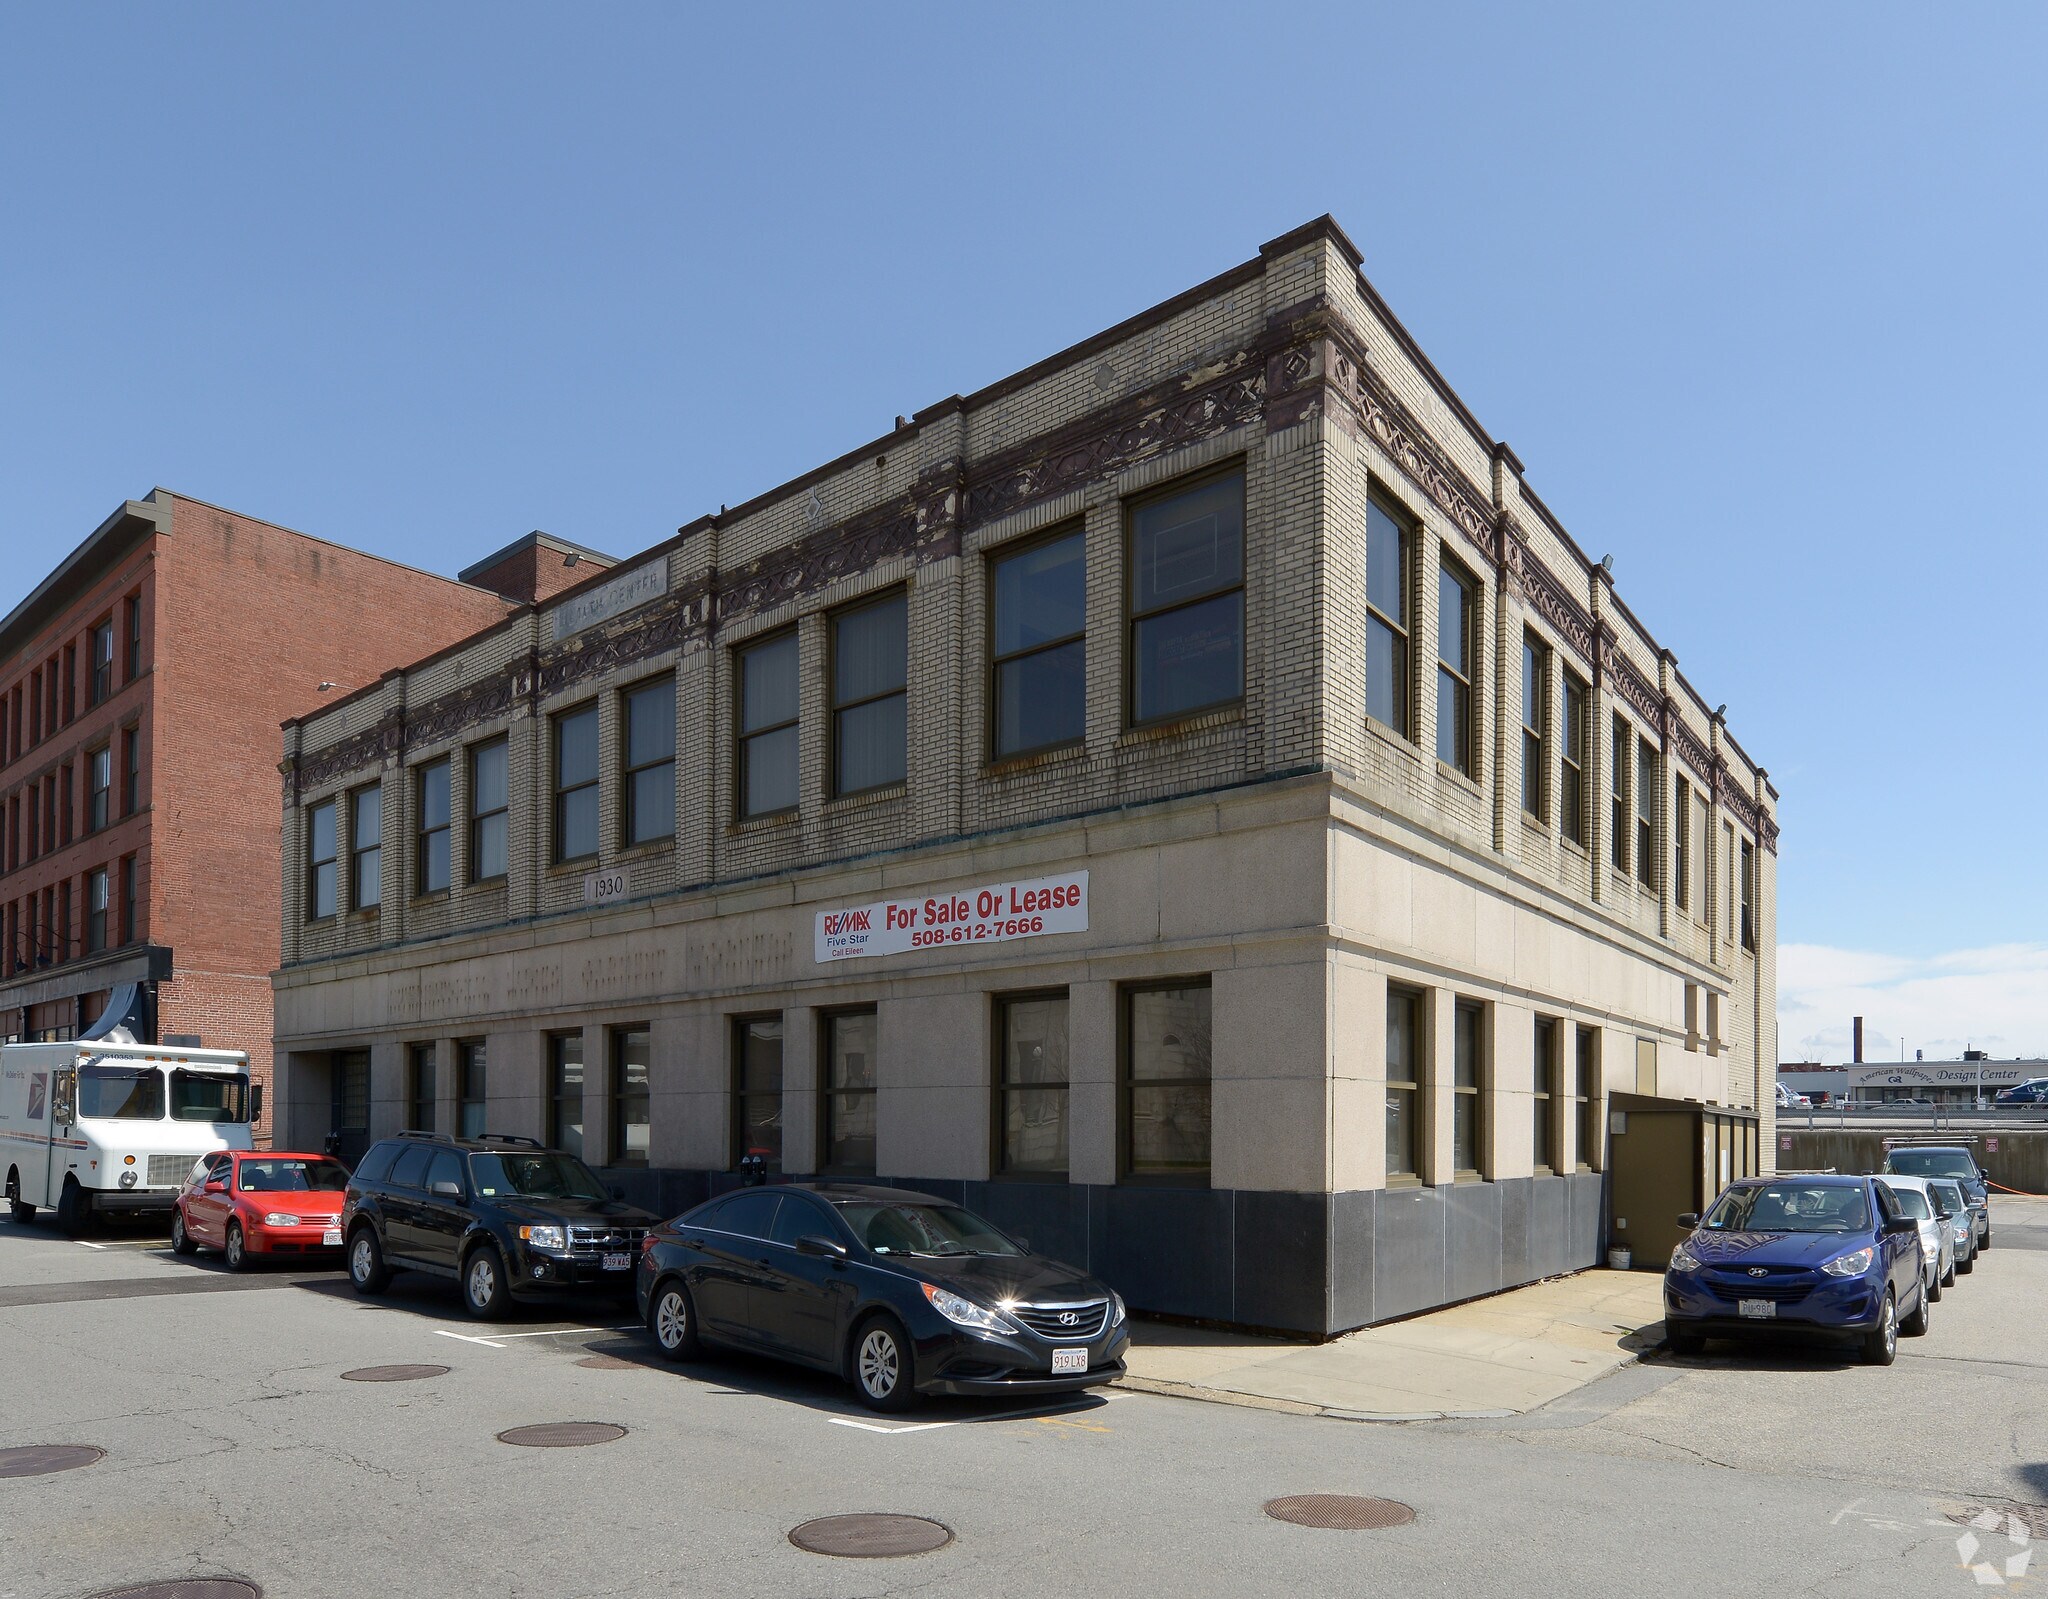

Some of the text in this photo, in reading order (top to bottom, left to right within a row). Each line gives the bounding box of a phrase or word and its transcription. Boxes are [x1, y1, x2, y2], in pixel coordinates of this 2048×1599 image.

[595, 876, 623, 897] 1930
[886, 883, 1081, 931] For Sale Or Lease
[824, 909, 872, 936] RE/MAX
[911, 916, 1043, 947] 508-612-7666
[827, 934, 869, 947] Five Star
[832, 947, 864, 957] Call Eileen
[1860, 1067, 1935, 1086] American Wallpaper
[1936, 1069, 2020, 1082] Design Center
[1054, 1355, 1086, 1368] 919 LX8
